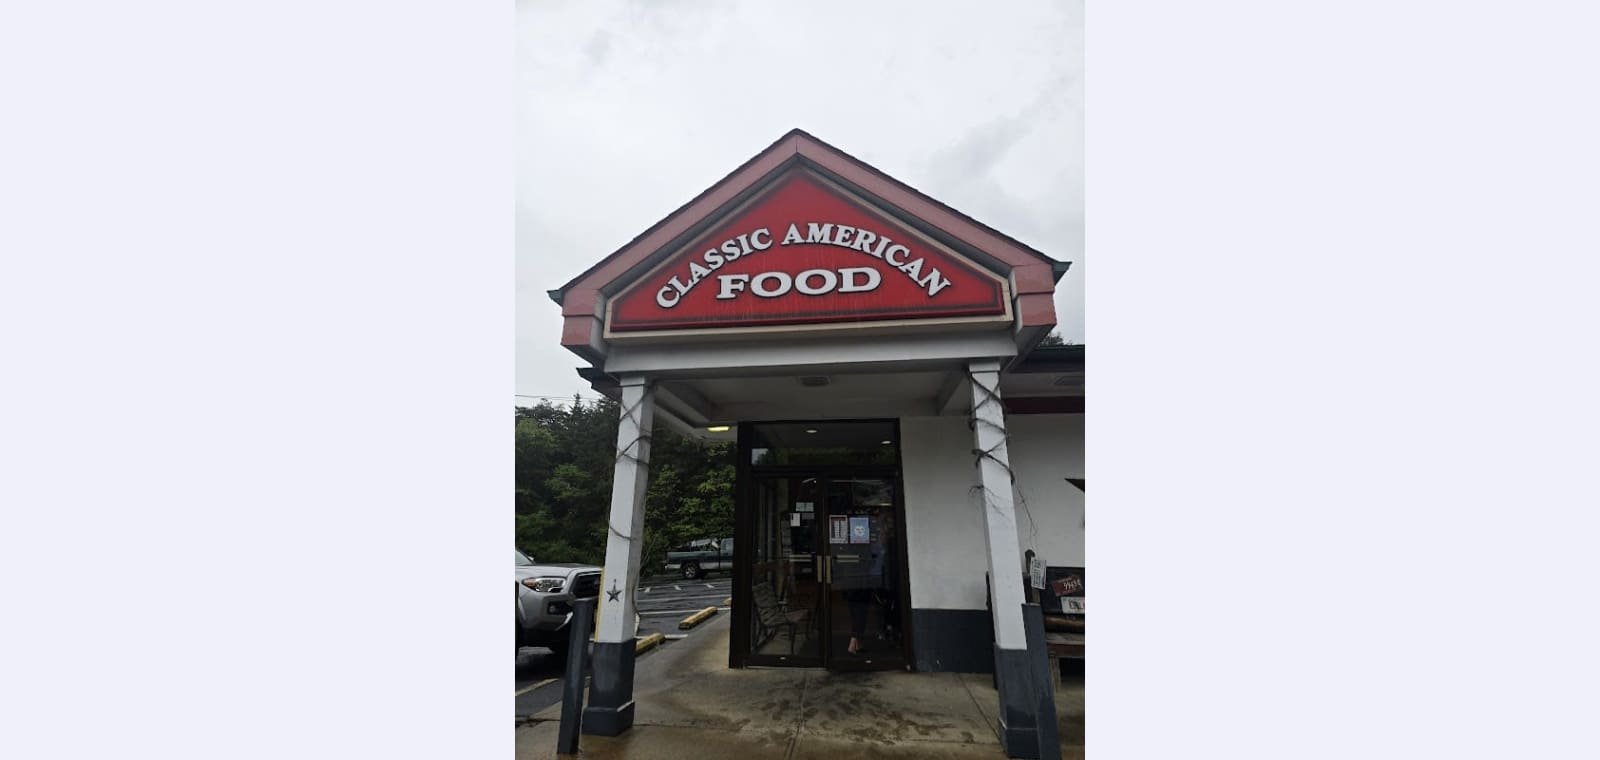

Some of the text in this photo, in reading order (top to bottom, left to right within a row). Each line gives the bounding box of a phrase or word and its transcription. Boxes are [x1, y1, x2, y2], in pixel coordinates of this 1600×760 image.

[656, 222, 951, 308] CLASSIC AMERICAN
[716, 267, 881, 299] FOOD
